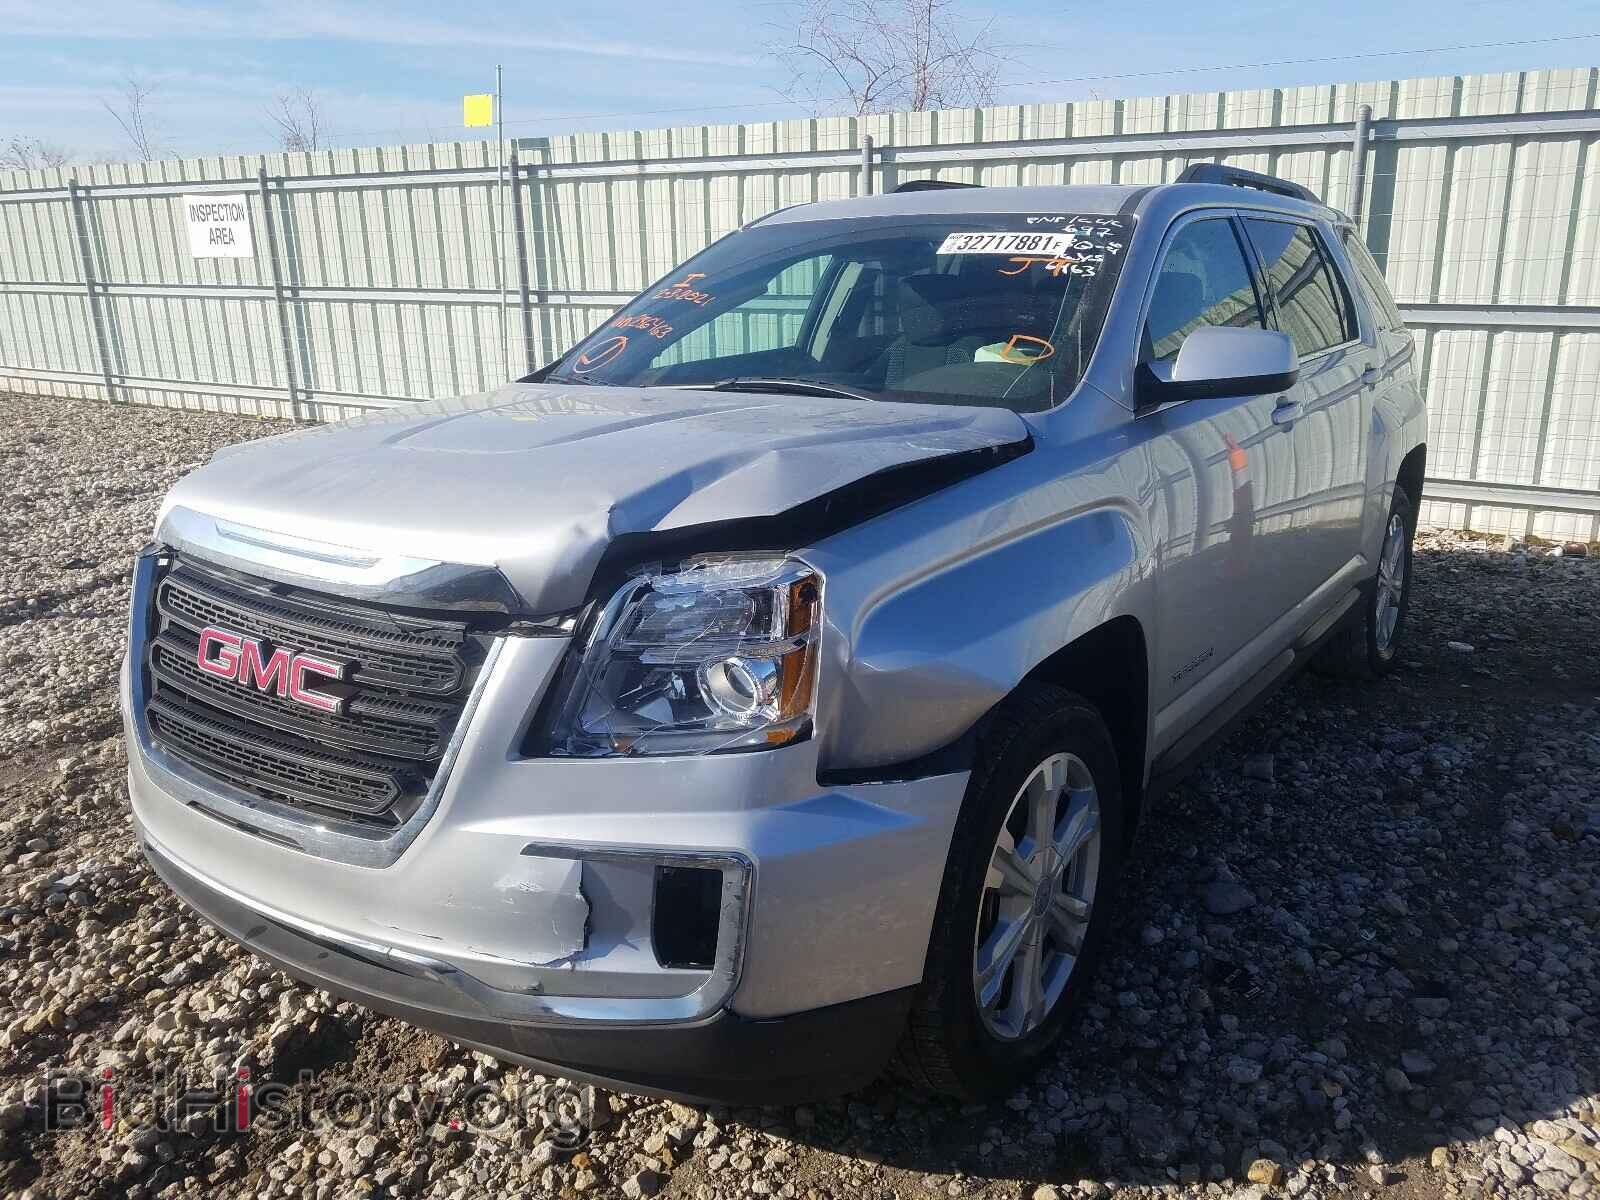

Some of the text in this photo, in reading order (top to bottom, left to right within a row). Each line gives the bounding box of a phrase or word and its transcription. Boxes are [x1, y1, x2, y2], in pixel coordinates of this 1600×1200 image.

[189, 203, 245, 222] INSPECTION
[209, 227, 236, 245] AREA
[957, 235, 1054, 251] 32717881
[1052, 241, 1064, 250] F
[198, 627, 345, 714] GMC
